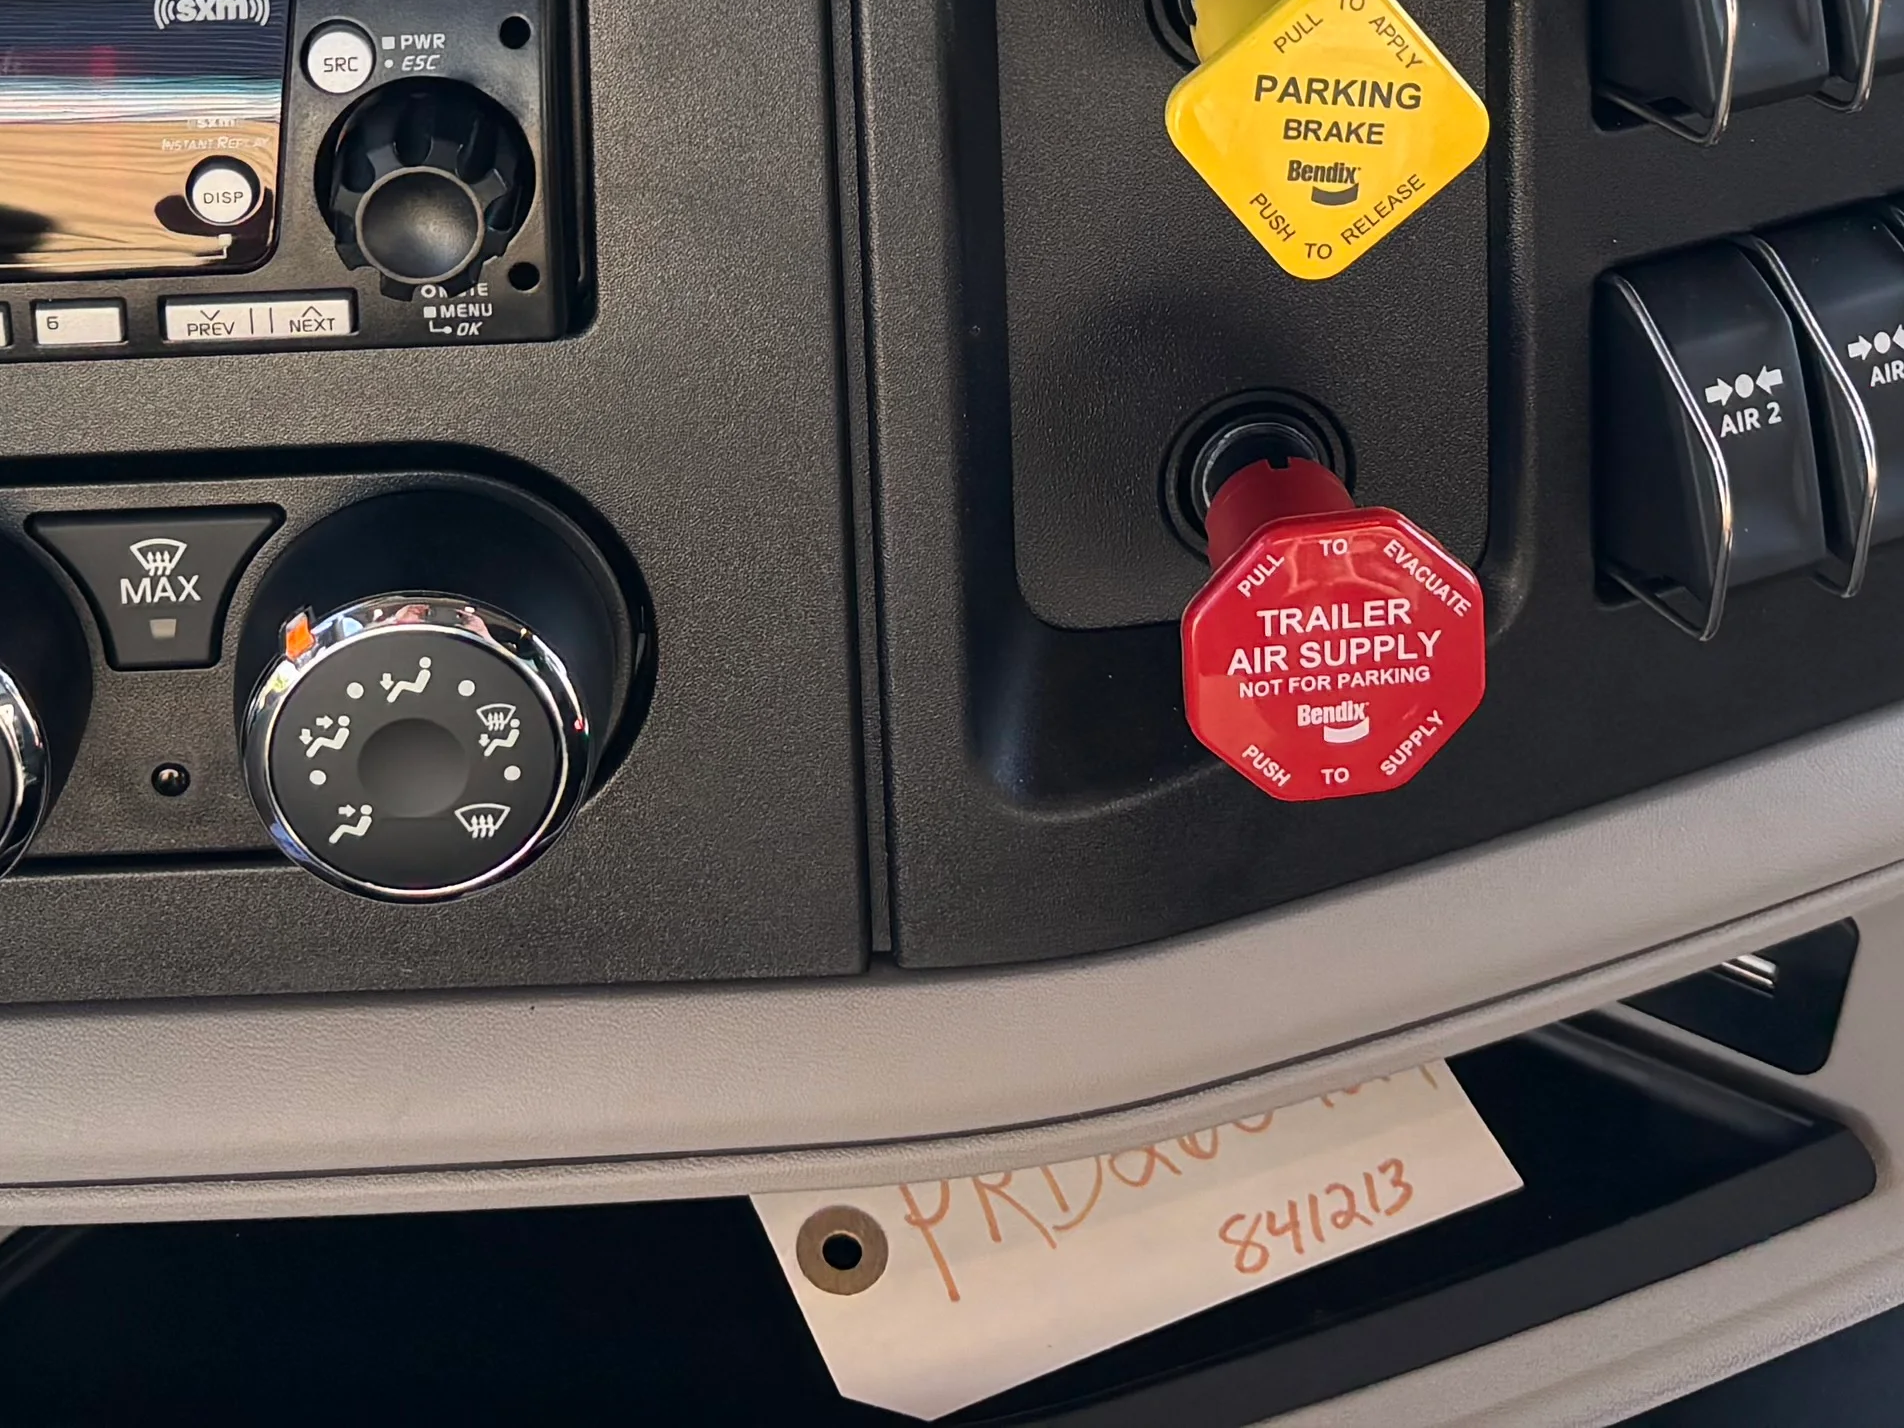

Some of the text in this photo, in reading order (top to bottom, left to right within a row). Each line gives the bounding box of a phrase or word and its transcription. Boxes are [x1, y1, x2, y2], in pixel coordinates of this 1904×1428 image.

[400, 33, 445, 50] PWR
[1273, 12, 1323, 54] PULL
[1369, 15, 1423, 69] APPLY
[324, 56, 358, 72] SRC
[402, 55, 440, 71] ESC
[1254, 74, 1422, 110] PARKING
[1283, 119, 1385, 145] BRAKE
[1287, 160, 1359, 185] Bendix
[203, 192, 244, 204] DISP
[1249, 173, 1426, 260] PUSH TO RELEASE
[46, 317, 59, 330] 6
[440, 303, 492, 318] MENU
[187, 322, 235, 338] PREV
[289, 317, 336, 333] NEXT
[457, 322, 483, 336] OK
[1719, 400, 1782, 439] AIR 2
[120, 574, 202, 606] MAX
[1236, 539, 1472, 617] PULL TO EVACUATE
[1257, 597, 1412, 637] TRAILER
[1227, 630, 1442, 676] AIR SUPPLY
[1239, 666, 1430, 699] NOT FOR PARKING
[1297, 700, 1366, 727] Bendix
[1241, 709, 1445, 787] PUSH TO SUPPLY
[1218, 1157, 1415, 1275] 841213
